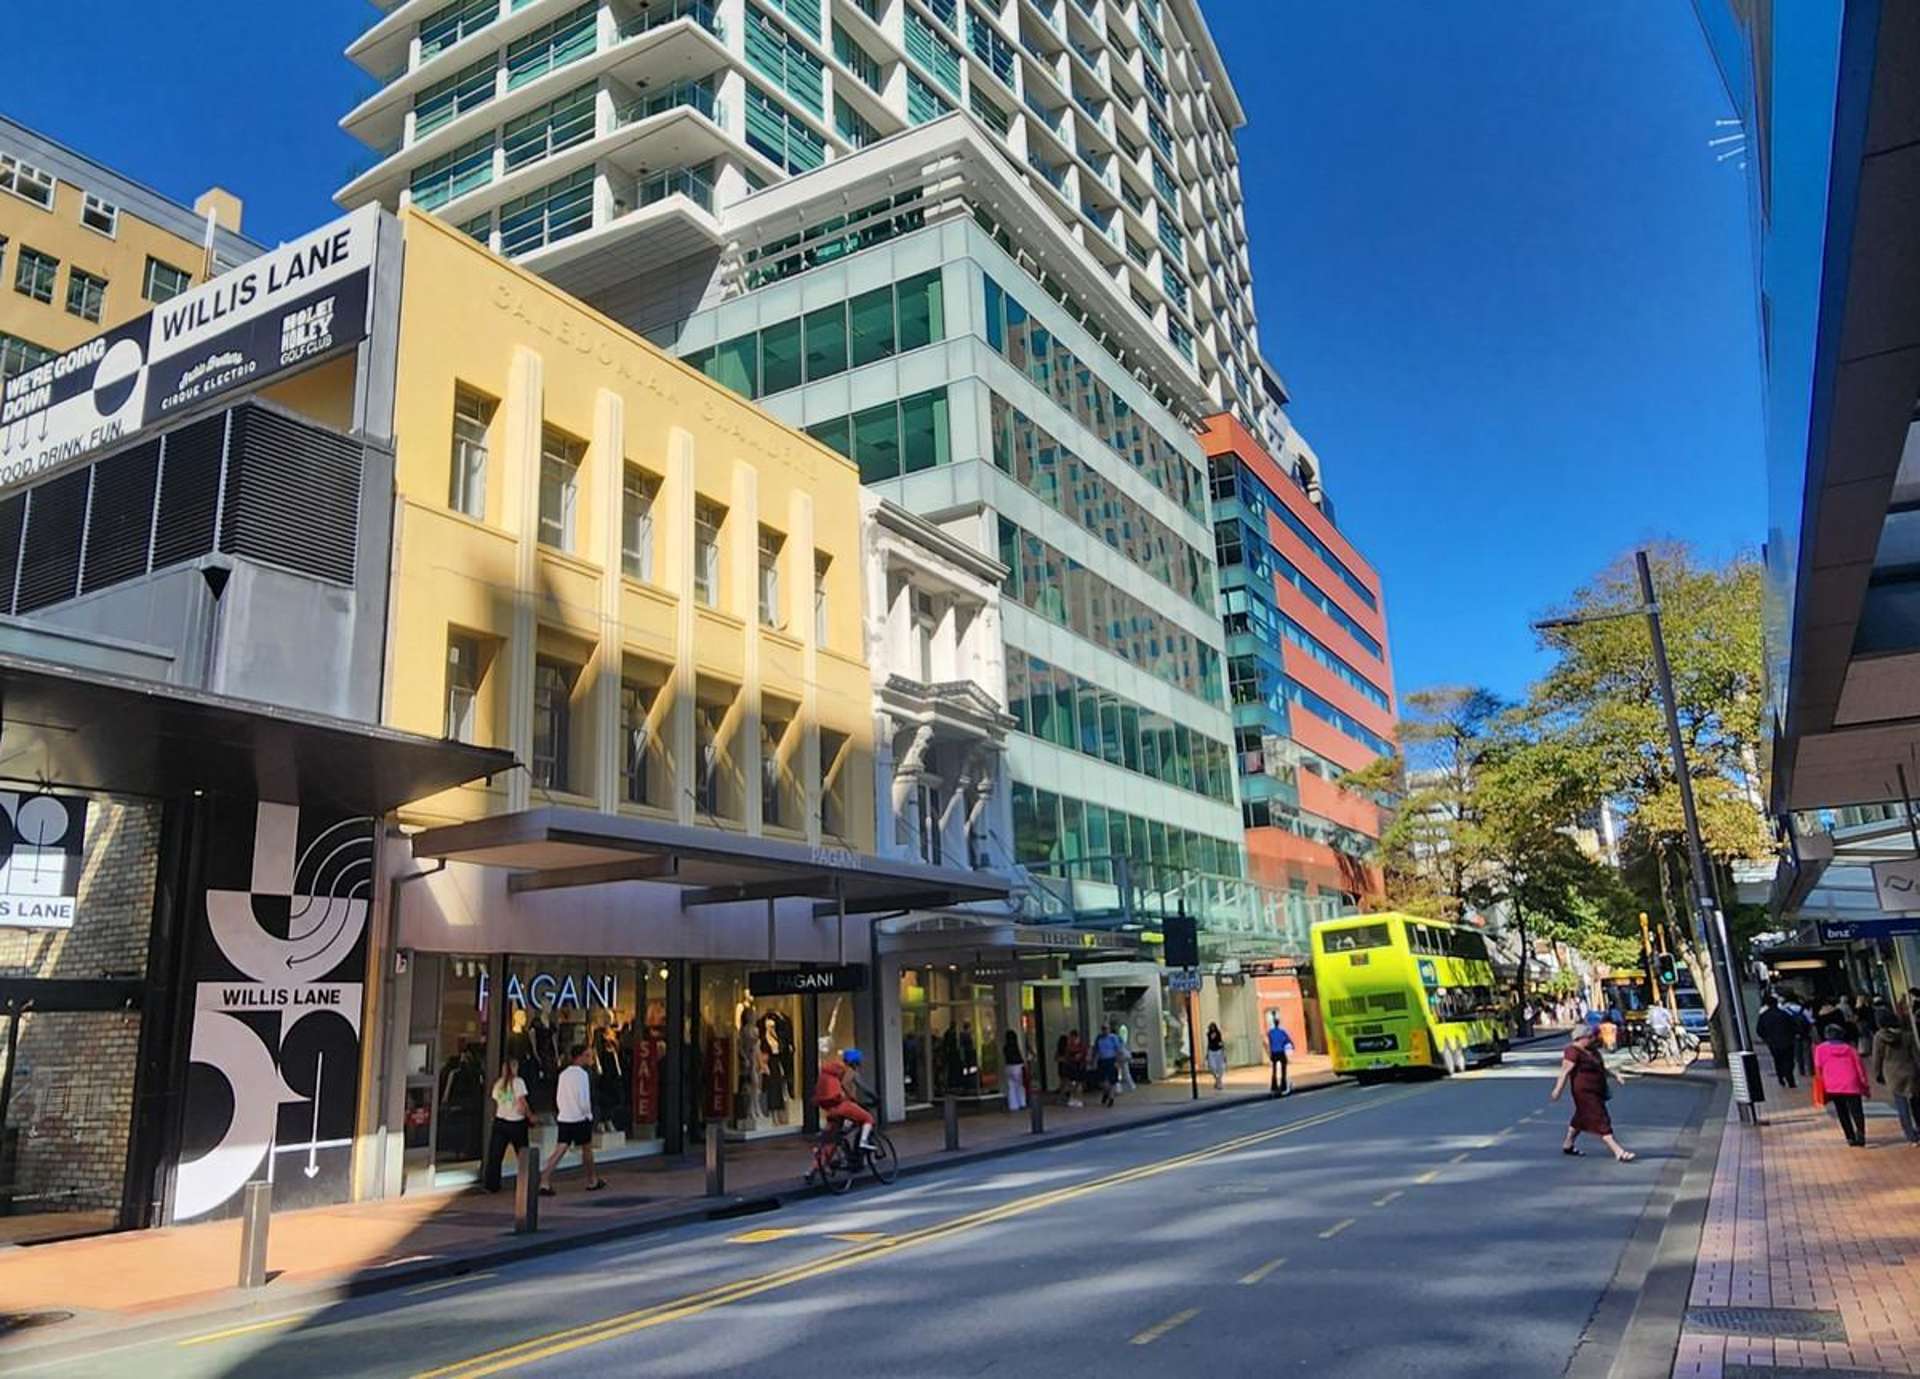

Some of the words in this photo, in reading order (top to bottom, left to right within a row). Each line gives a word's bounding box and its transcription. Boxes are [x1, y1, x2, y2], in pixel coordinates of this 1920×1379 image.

[163, 274, 256, 342] WILLIS
[267, 228, 351, 295] LANE
[54, 338, 107, 379] GOING
[2, 384, 52, 424] DOWN
[18, 902, 72, 918] LANE
[223, 989, 288, 1005] WILLIS
[294, 988, 341, 1005] LANE
[639, 1041, 650, 1115] SALE
[713, 1040, 724, 1111] SALE
